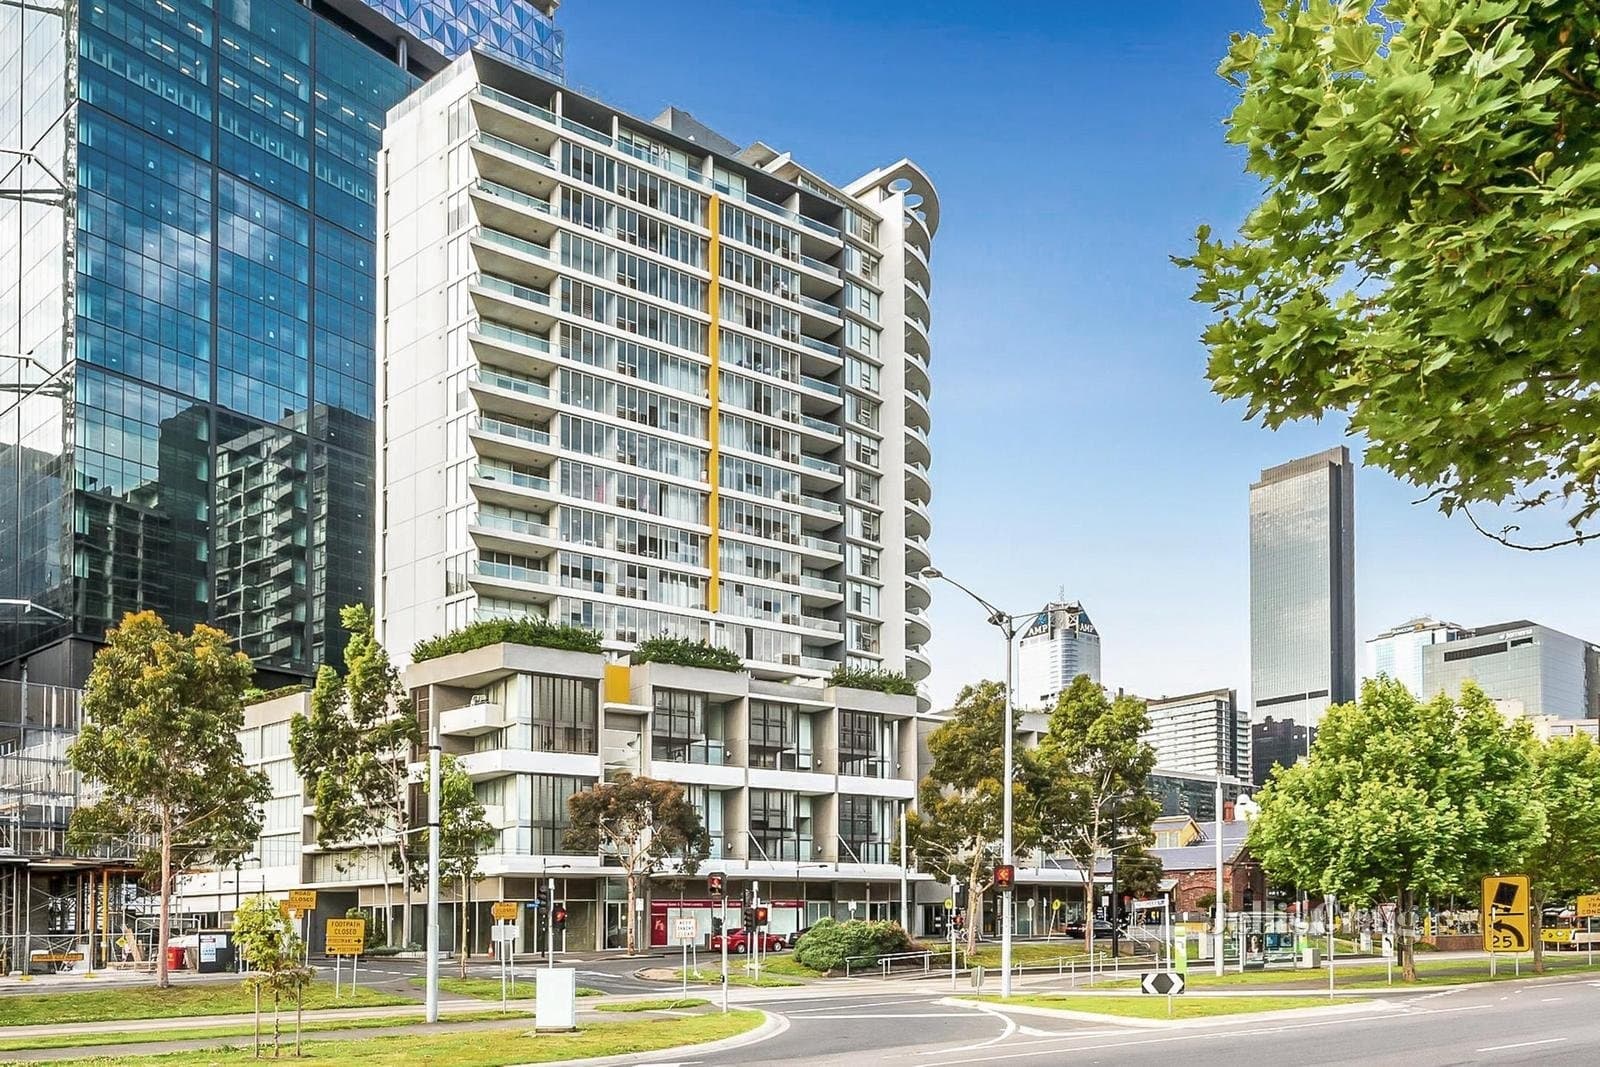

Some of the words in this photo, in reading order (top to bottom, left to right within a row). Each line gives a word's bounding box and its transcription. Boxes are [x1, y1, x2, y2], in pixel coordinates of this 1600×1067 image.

[1028, 624, 1048, 637] AMP
[1080, 623, 1095, 633] AMP
[1493, 935, 1513, 949] 25
